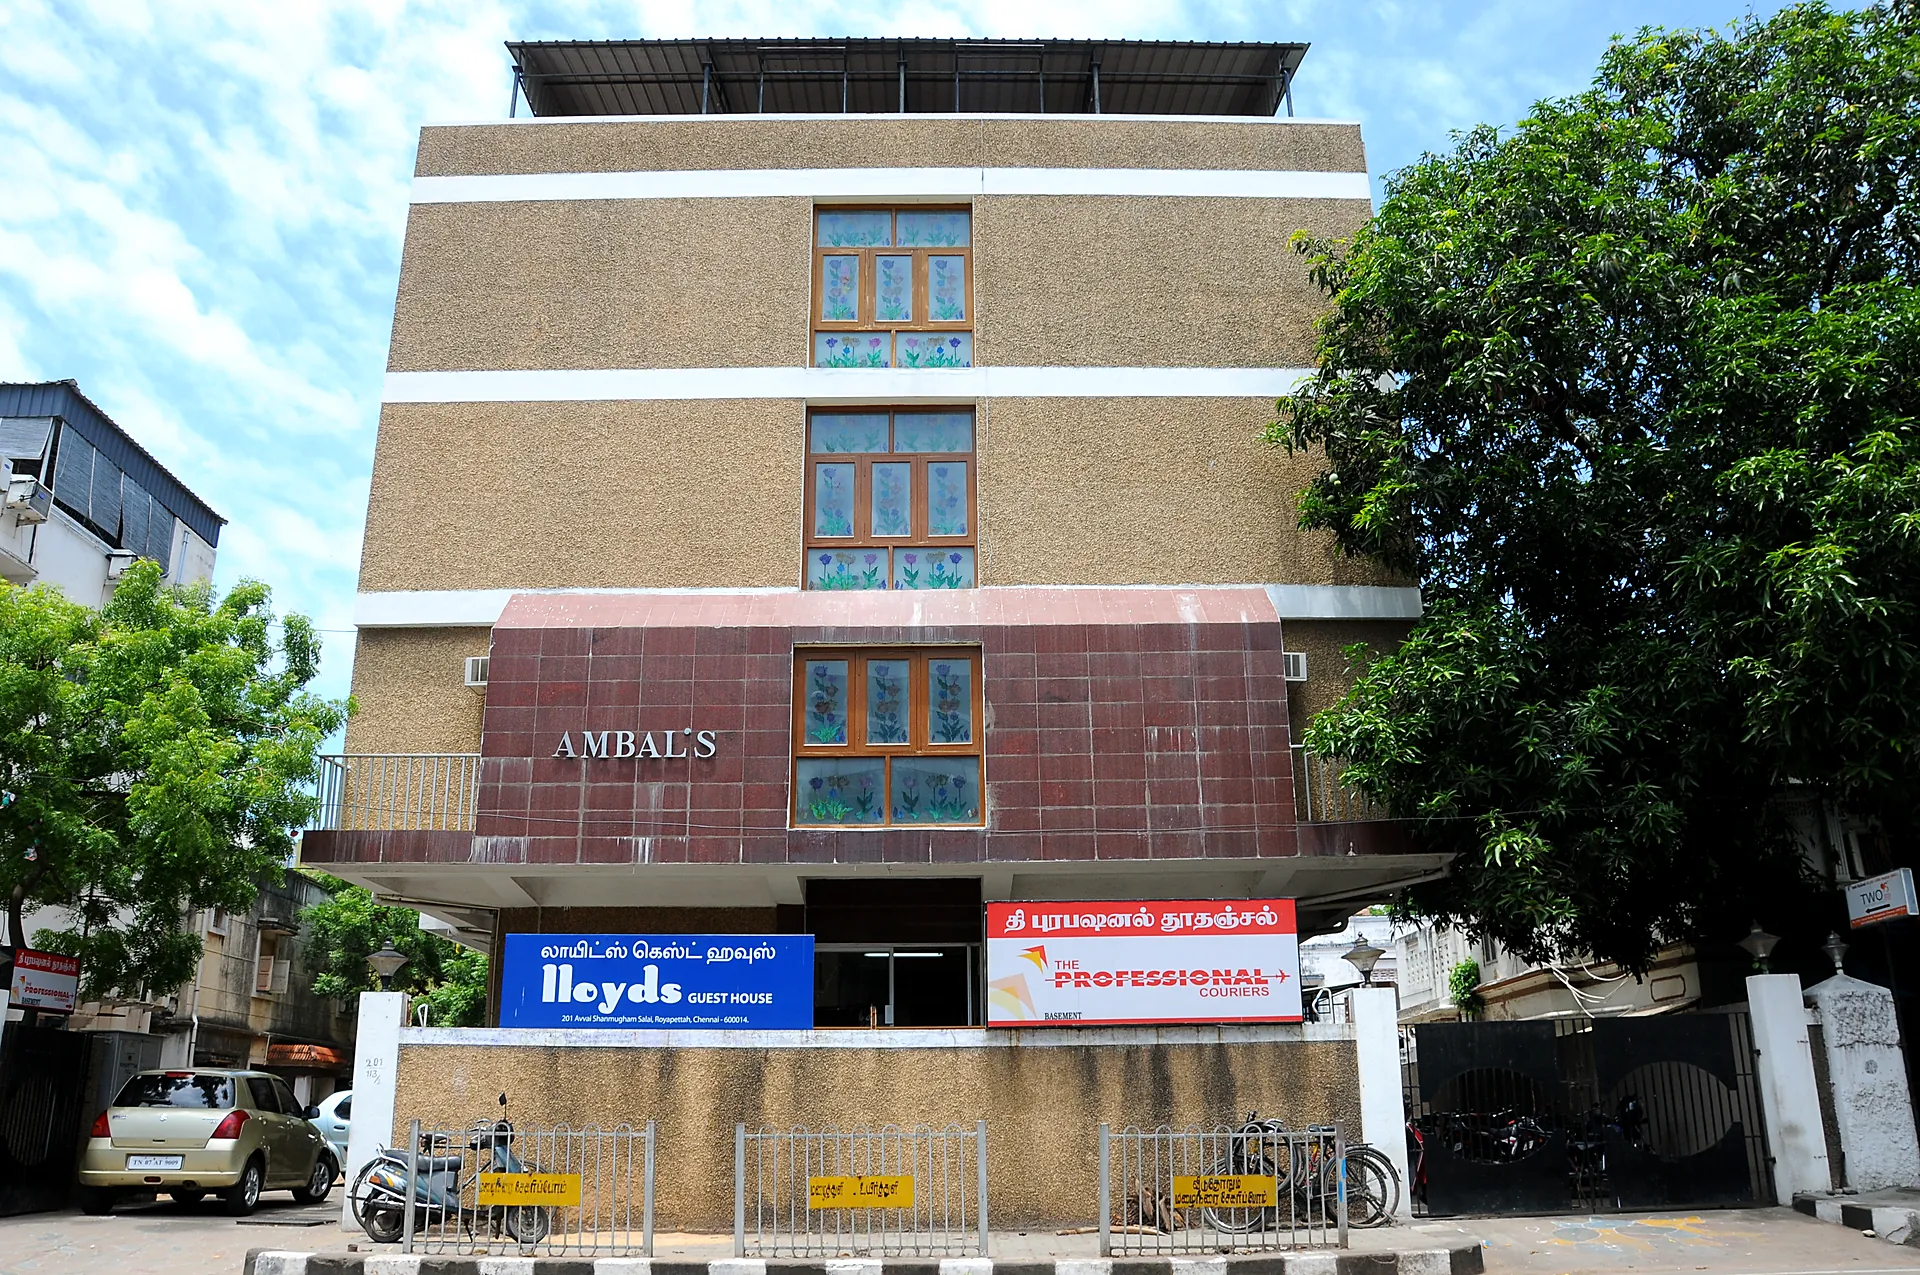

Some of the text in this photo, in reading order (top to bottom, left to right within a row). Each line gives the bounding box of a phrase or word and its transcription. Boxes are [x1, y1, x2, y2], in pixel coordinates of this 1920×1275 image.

[552, 728, 716, 758] AMBAL'S
[1860, 889, 1883, 905] TWO
[540, 940, 776, 964] லாயிட்ஸ் கெஸ்ட் ஹவுஸ்
[1055, 960, 1079, 970] THE
[1054, 968, 1269, 988] PROFESSIONAL
[24, 986, 69, 998] PROFESSIONAL
[542, 964, 682, 1014] lloyds
[1199, 987, 1270, 997] COURIERS
[688, 993, 773, 1004] GUEST HOUSE
[592, 1015, 637, 1024] Shanmugham
[638, 1016, 654, 1024] Salai,
[655, 1016, 692, 1025] Royapettah,
[1044, 1012, 1082, 1020] BASEMENT
[365, 1057, 383, 1067] 201
